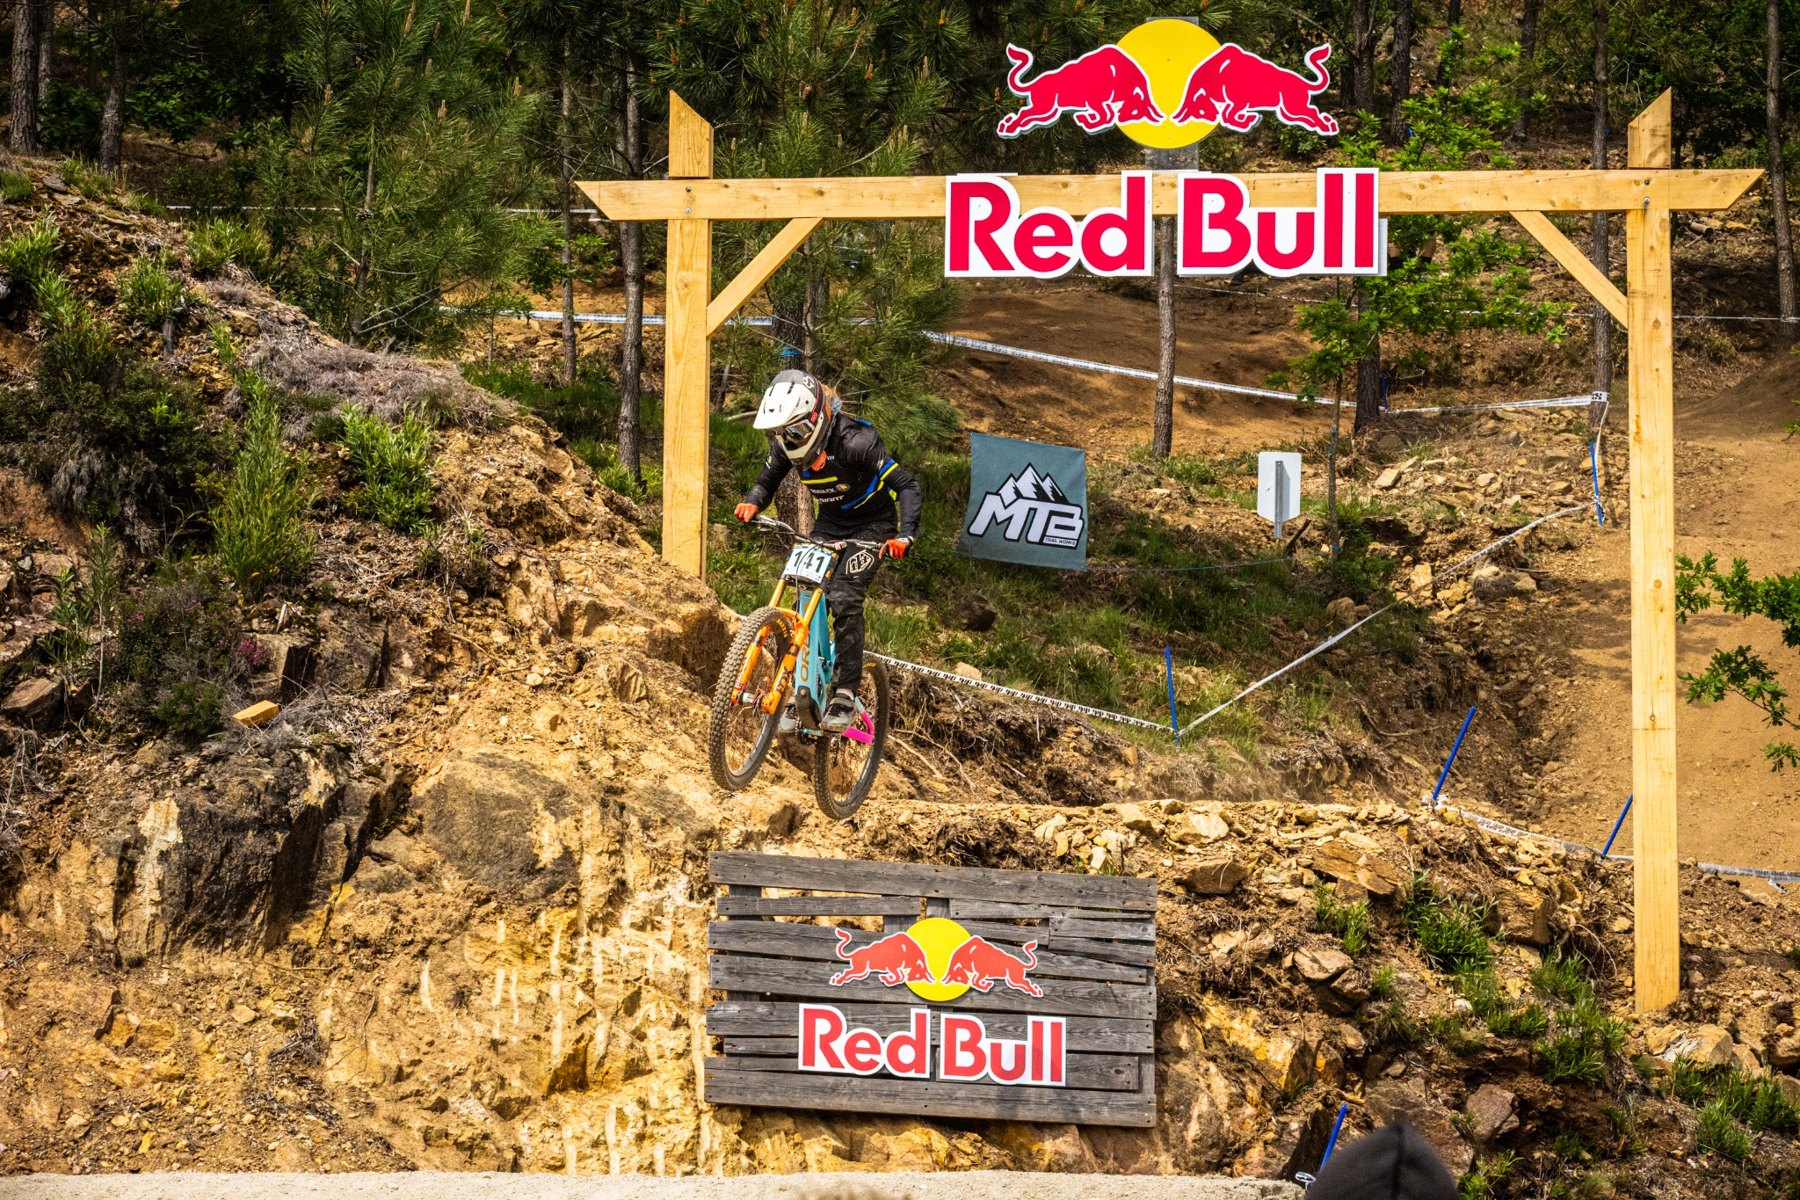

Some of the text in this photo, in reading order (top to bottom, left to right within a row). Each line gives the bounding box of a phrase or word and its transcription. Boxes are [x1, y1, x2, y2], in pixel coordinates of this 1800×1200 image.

[949, 172, 1375, 272] Red Bull
[968, 492, 1084, 545] MTB
[793, 550, 825, 573] 141
[801, 1007, 1063, 1082] Red Bull
